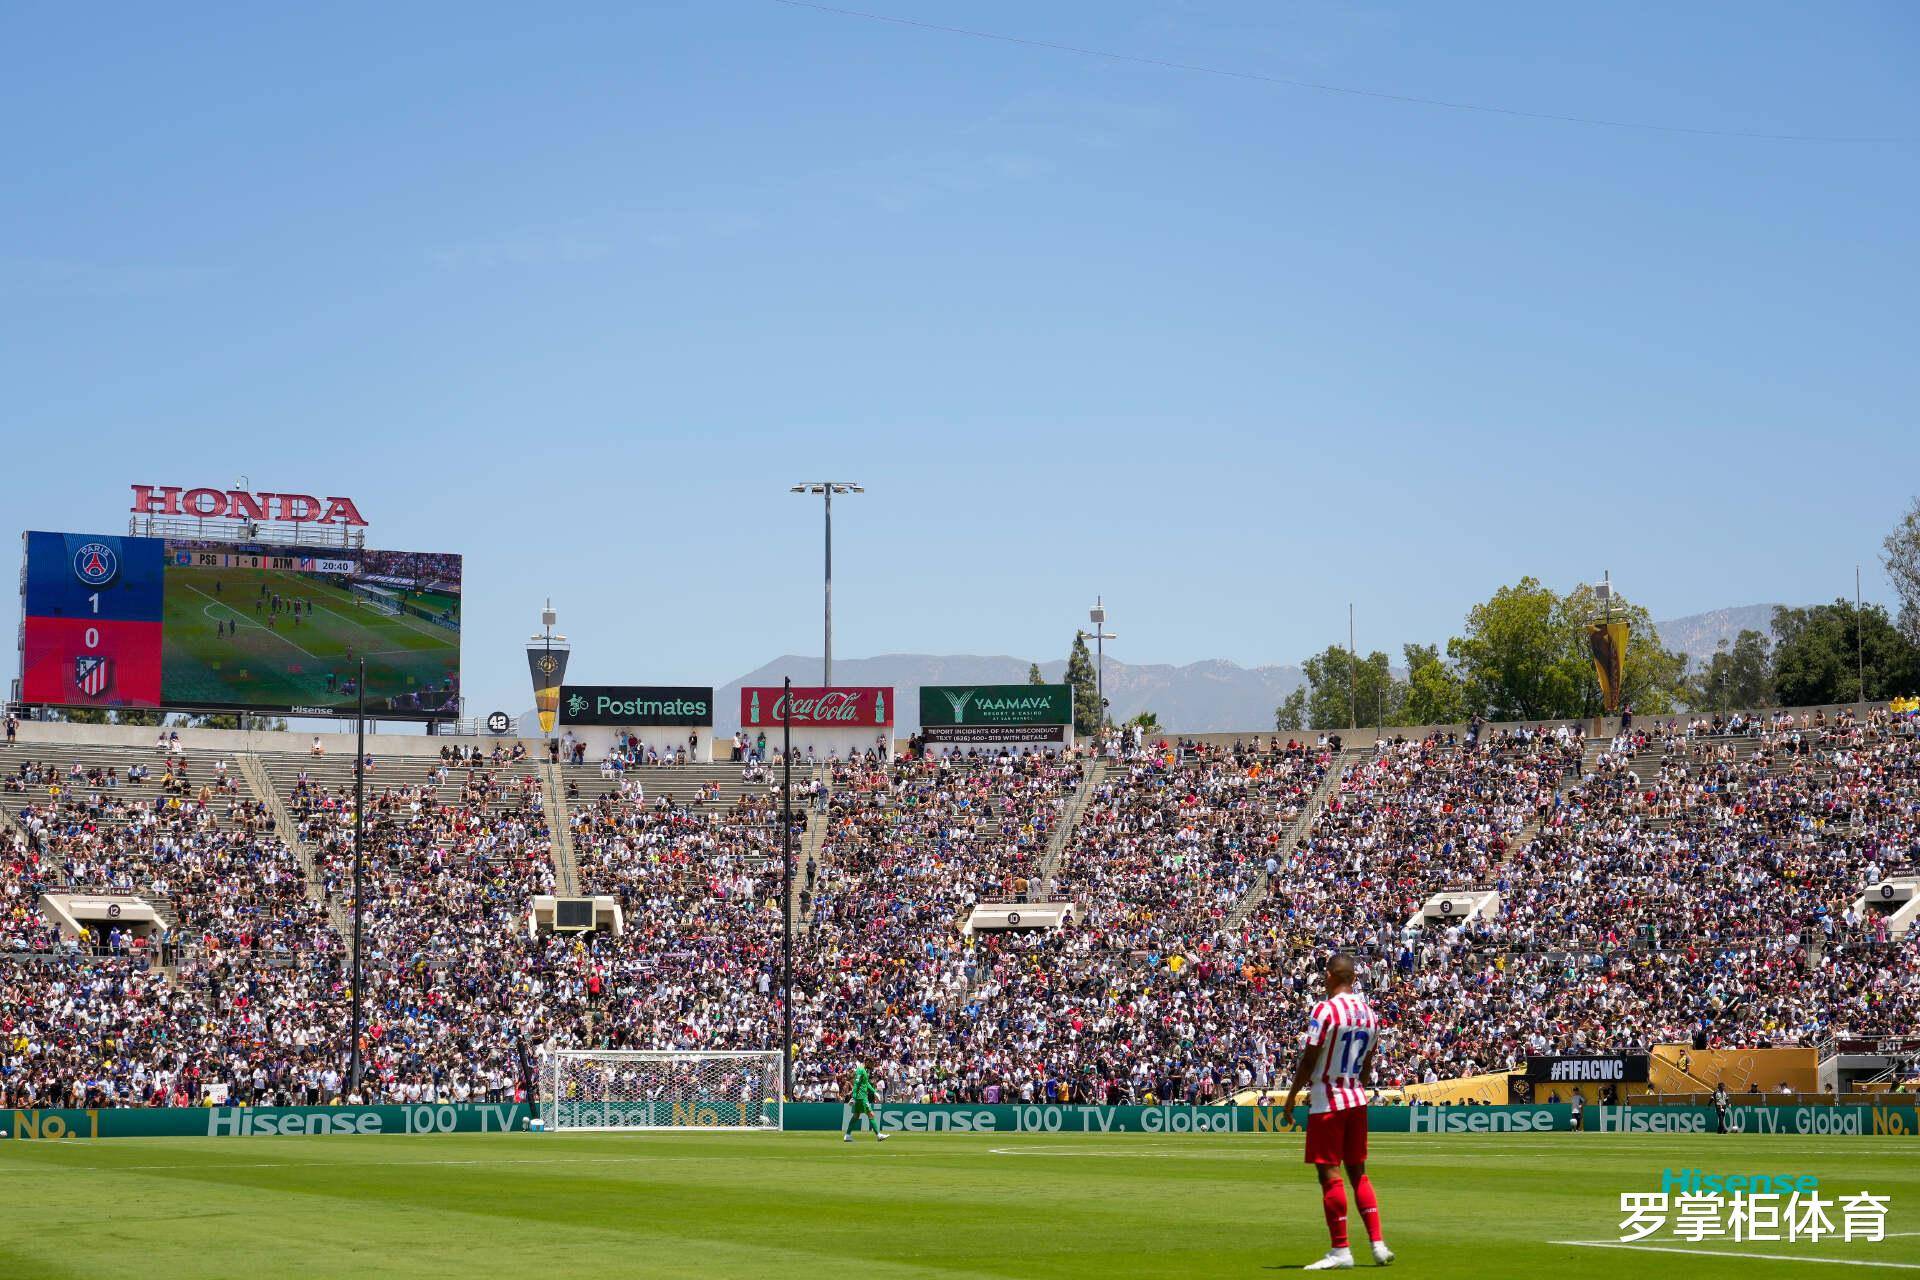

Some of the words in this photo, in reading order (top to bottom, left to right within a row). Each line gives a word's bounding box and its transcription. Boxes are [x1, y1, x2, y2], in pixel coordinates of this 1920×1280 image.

[130, 484, 369, 526] HONDA
[81, 545, 110, 558] PARIS
[200, 554, 217, 565] PSG
[235, 557, 240, 567] 1
[252, 557, 258, 568] 0
[272, 557, 293, 570] ATM
[322, 561, 349, 572] 20:40
[88, 592, 99, 613] 1
[85, 628, 99, 648] 0
[291, 705, 334, 715] Hisense
[597, 696, 707, 716] Postmates
[772, 691, 863, 721] Coca-Cola
[489, 715, 506, 730] 42
[110, 907, 119, 915] 12
[1443, 902, 1450, 911] 9
[1009, 914, 1018, 922] 10
[1340, 1031, 1369, 1073] 12
[1877, 1041, 1903, 1051] EXIT
[1551, 1060, 1624, 1081] #FIFACWC
[13, 1110, 76, 1139] No.
[86, 1110, 99, 1138] 1
[207, 1107, 383, 1137] Hisense
[401, 1104, 469, 1134] 100"
[544, 1101, 655, 1128] Global
[672, 1102, 729, 1128] No.
[735, 1103, 748, 1127] 1
[1012, 1105, 1073, 1132] 100"
[1077, 1106, 1126, 1133] TV,
[1140, 1106, 1238, 1133] Global
[1252, 1106, 1303, 1133] No.
[1409, 1105, 1554, 1133] Hisense
[1600, 1106, 1706, 1132] Hisense
[1720, 1106, 1751, 1133] 00"
[1754, 1107, 1787, 1134] TV,
[1795, 1107, 1863, 1135] Global
[1872, 1107, 1910, 1135] No.
